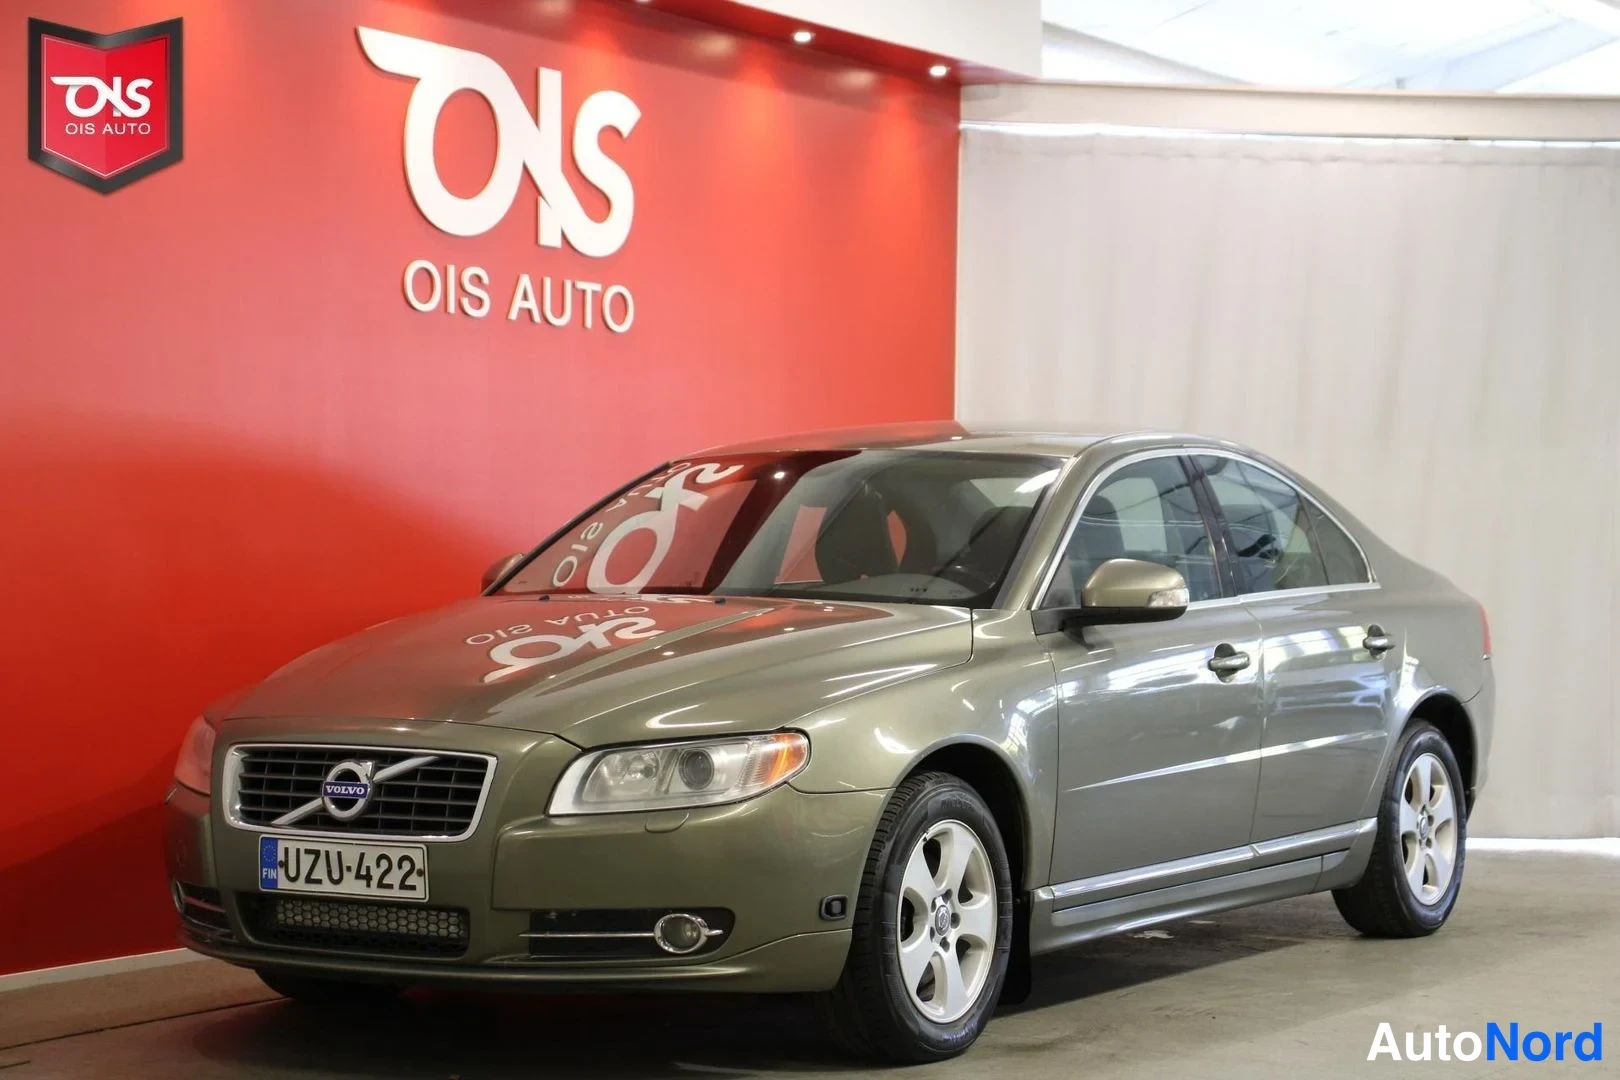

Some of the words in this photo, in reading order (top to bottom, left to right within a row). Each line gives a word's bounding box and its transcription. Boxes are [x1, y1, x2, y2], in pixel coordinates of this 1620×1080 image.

[403, 259, 491, 318] OIS
[507, 273, 635, 333] AUTO
[326, 785, 365, 795] VOLVO
[262, 868, 277, 880] FIN
[284, 847, 417, 891] UZU-422
